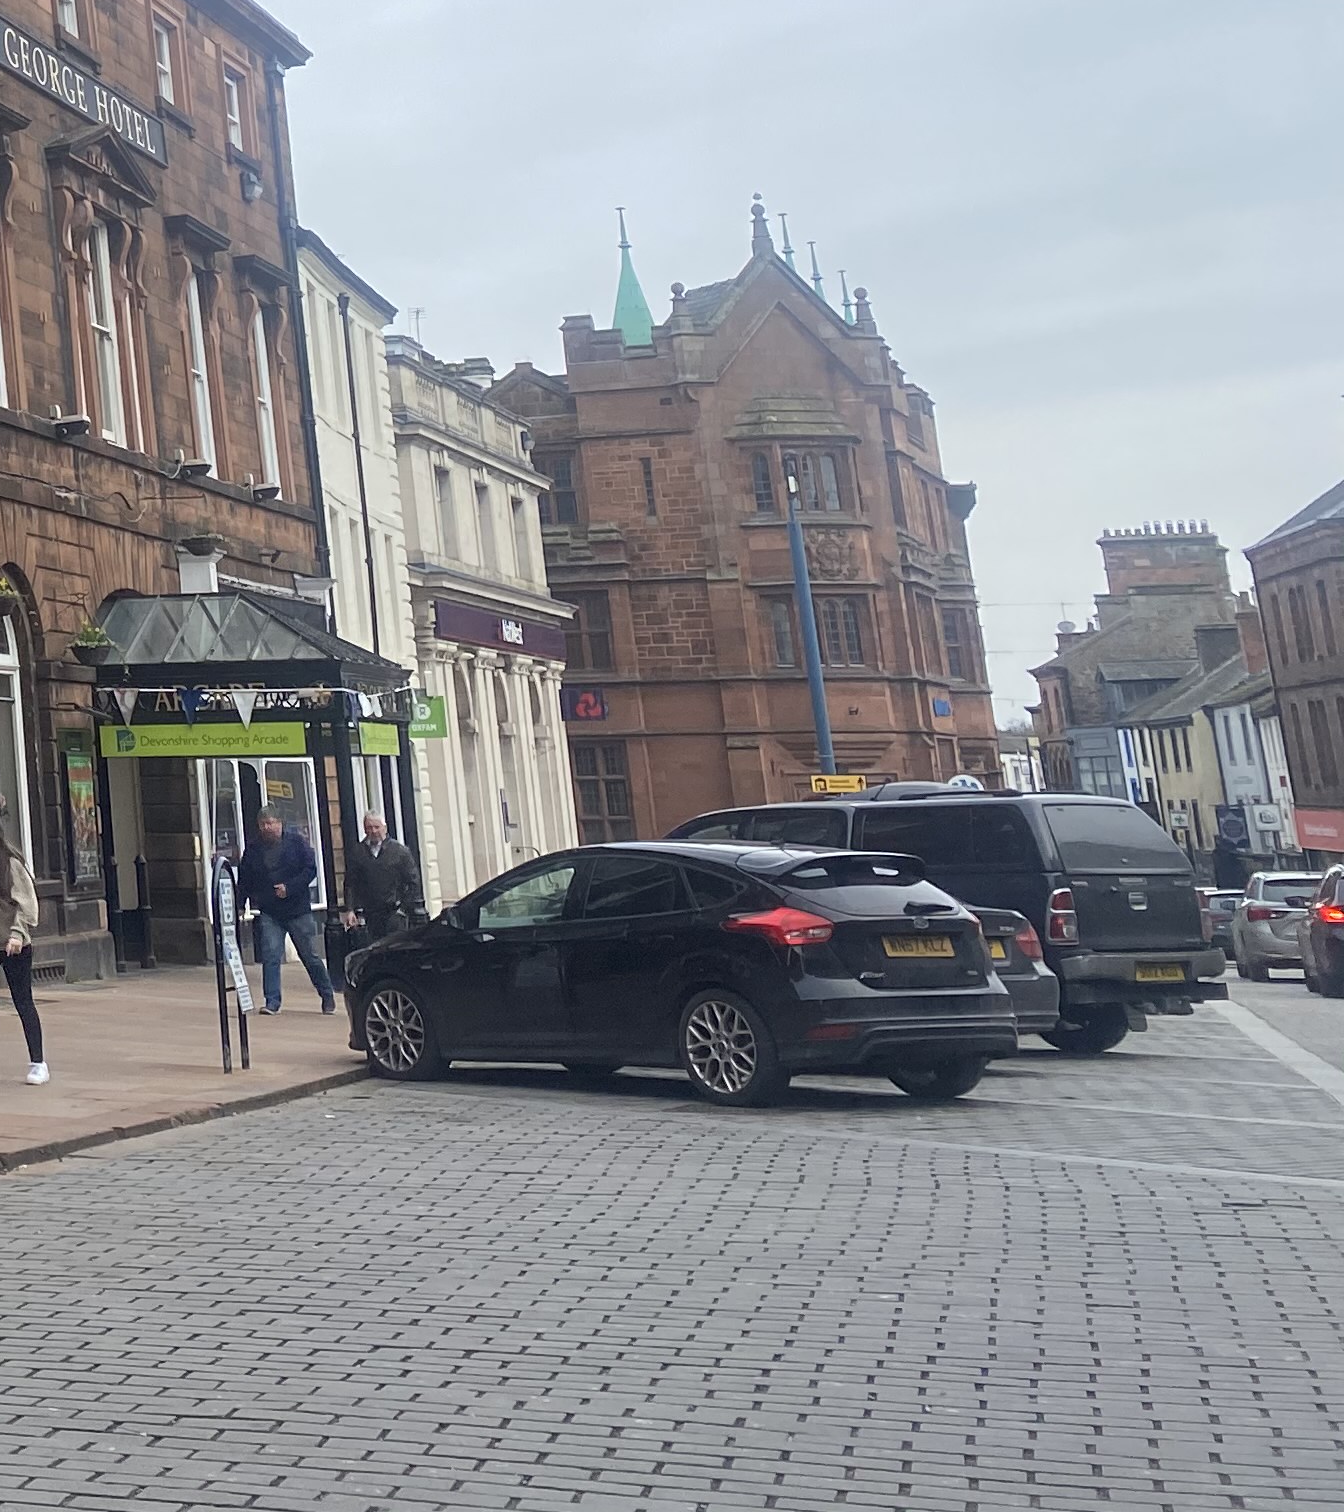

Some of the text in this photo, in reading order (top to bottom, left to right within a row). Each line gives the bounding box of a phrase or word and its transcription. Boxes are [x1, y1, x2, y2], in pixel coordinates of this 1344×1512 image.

[3, 27, 156, 154] GEORGE HOTEL
[412, 723, 437, 733] OXFAM
[140, 733, 289, 748] Devonshire Shopping Arcade
